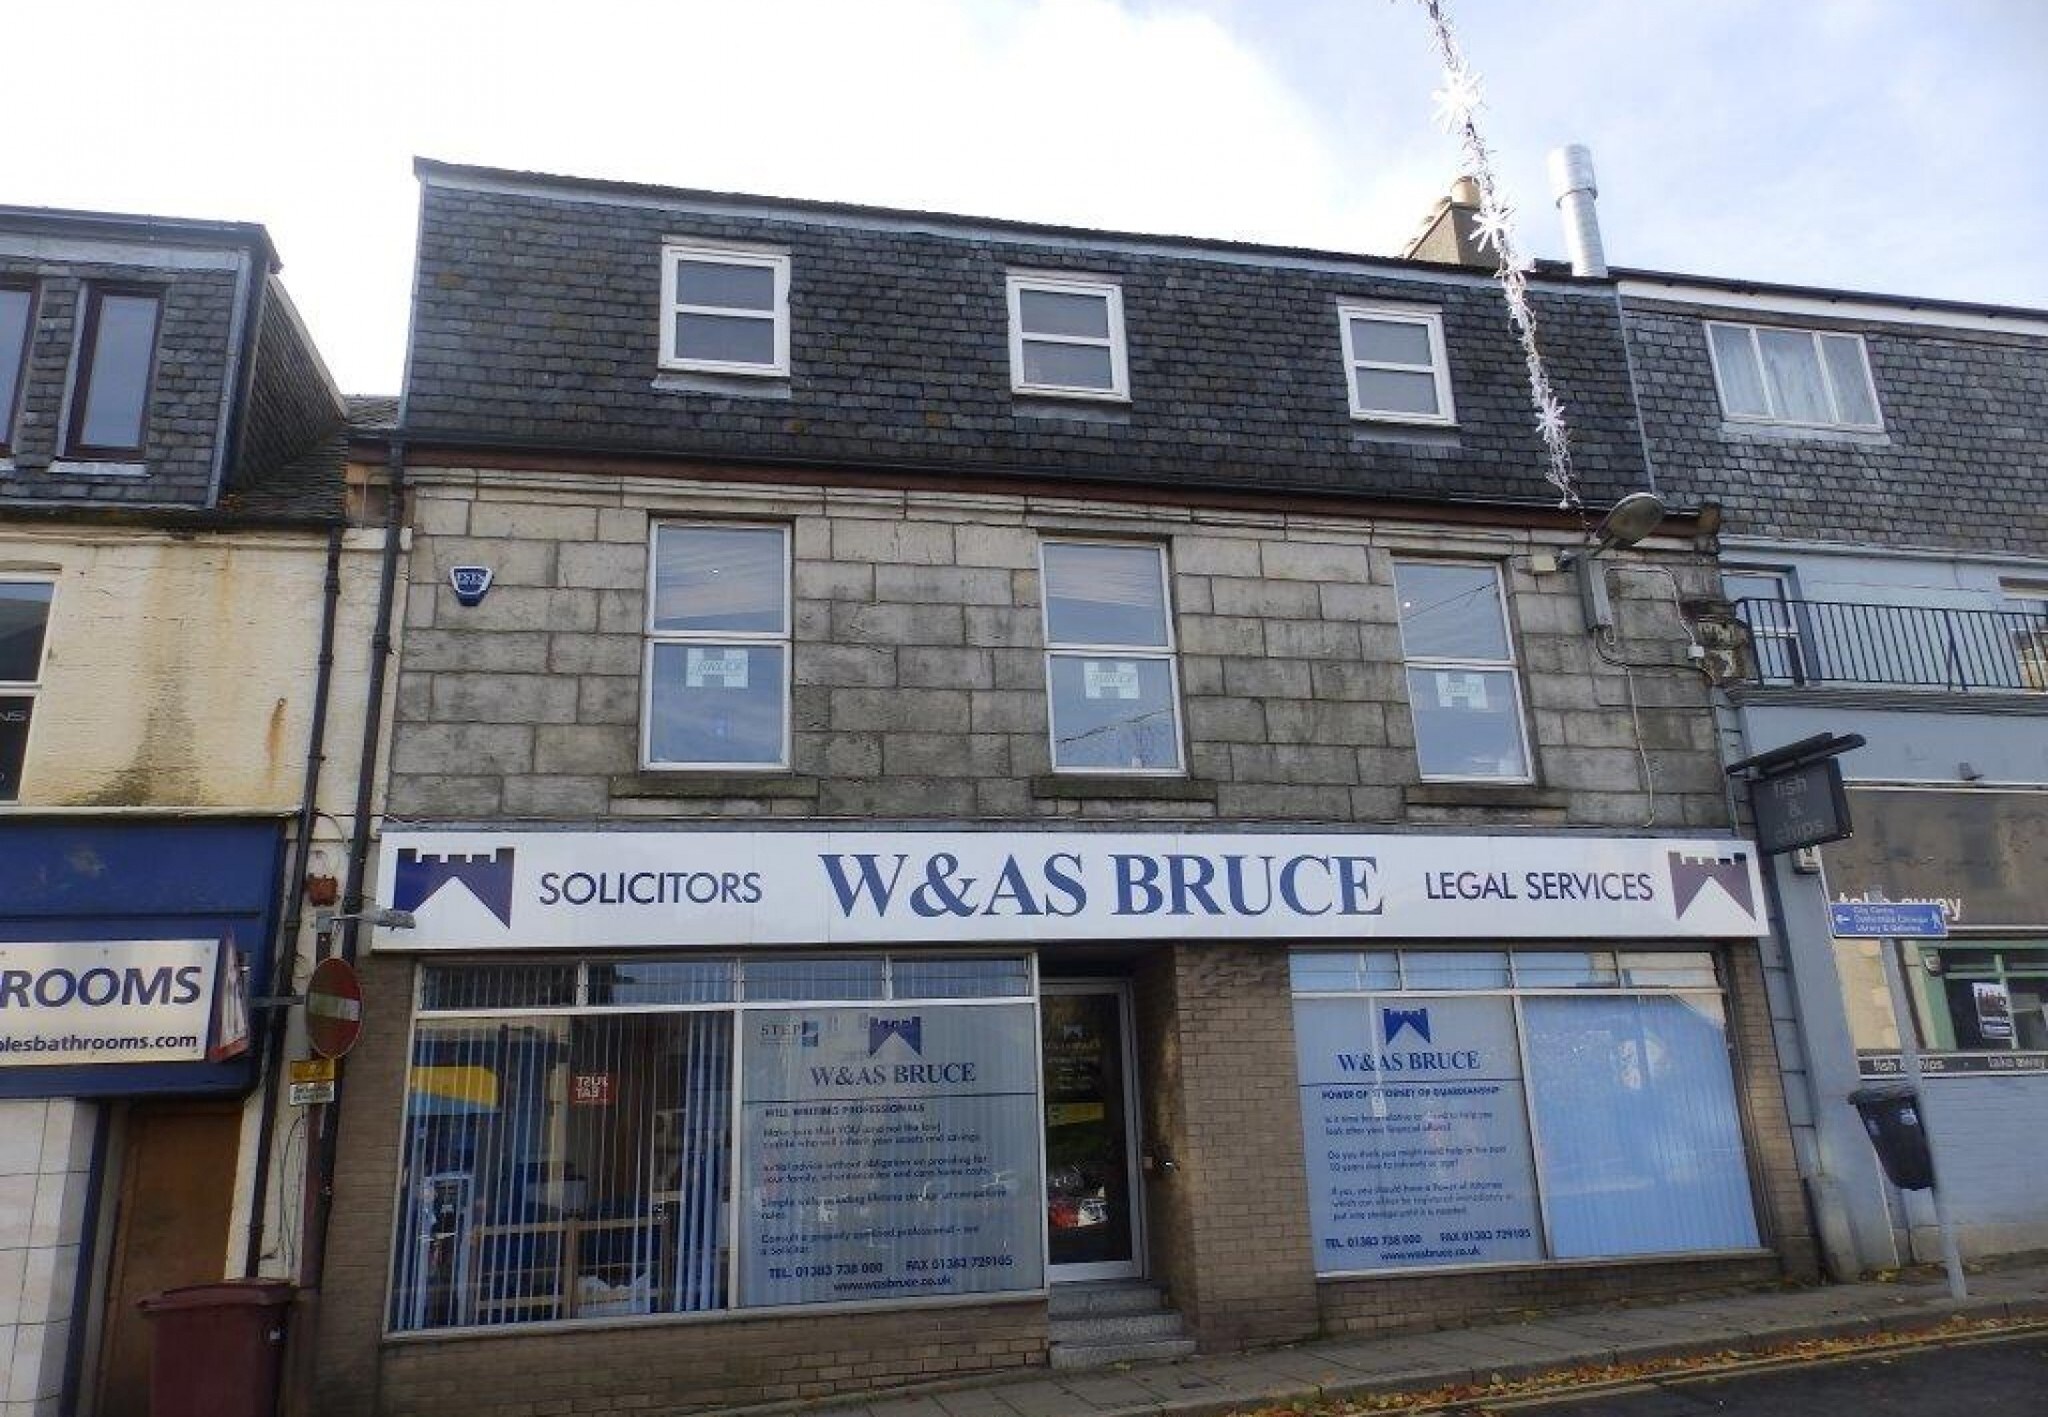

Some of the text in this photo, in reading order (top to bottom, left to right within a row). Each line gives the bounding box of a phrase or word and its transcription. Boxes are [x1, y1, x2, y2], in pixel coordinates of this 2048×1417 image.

[539, 870, 763, 905] SOLICITORS
[818, 850, 1384, 920] W&AS BRUCE
[1425, 871, 1654, 902] LEGAL SERVICES
[0, 1033, 197, 1053] lesbathrooms.com
[1409, 1050, 1481, 1070] BRUCE
[810, 1061, 977, 1086] W&AS BRUCE
[906, 1259, 929, 1271] FAX
